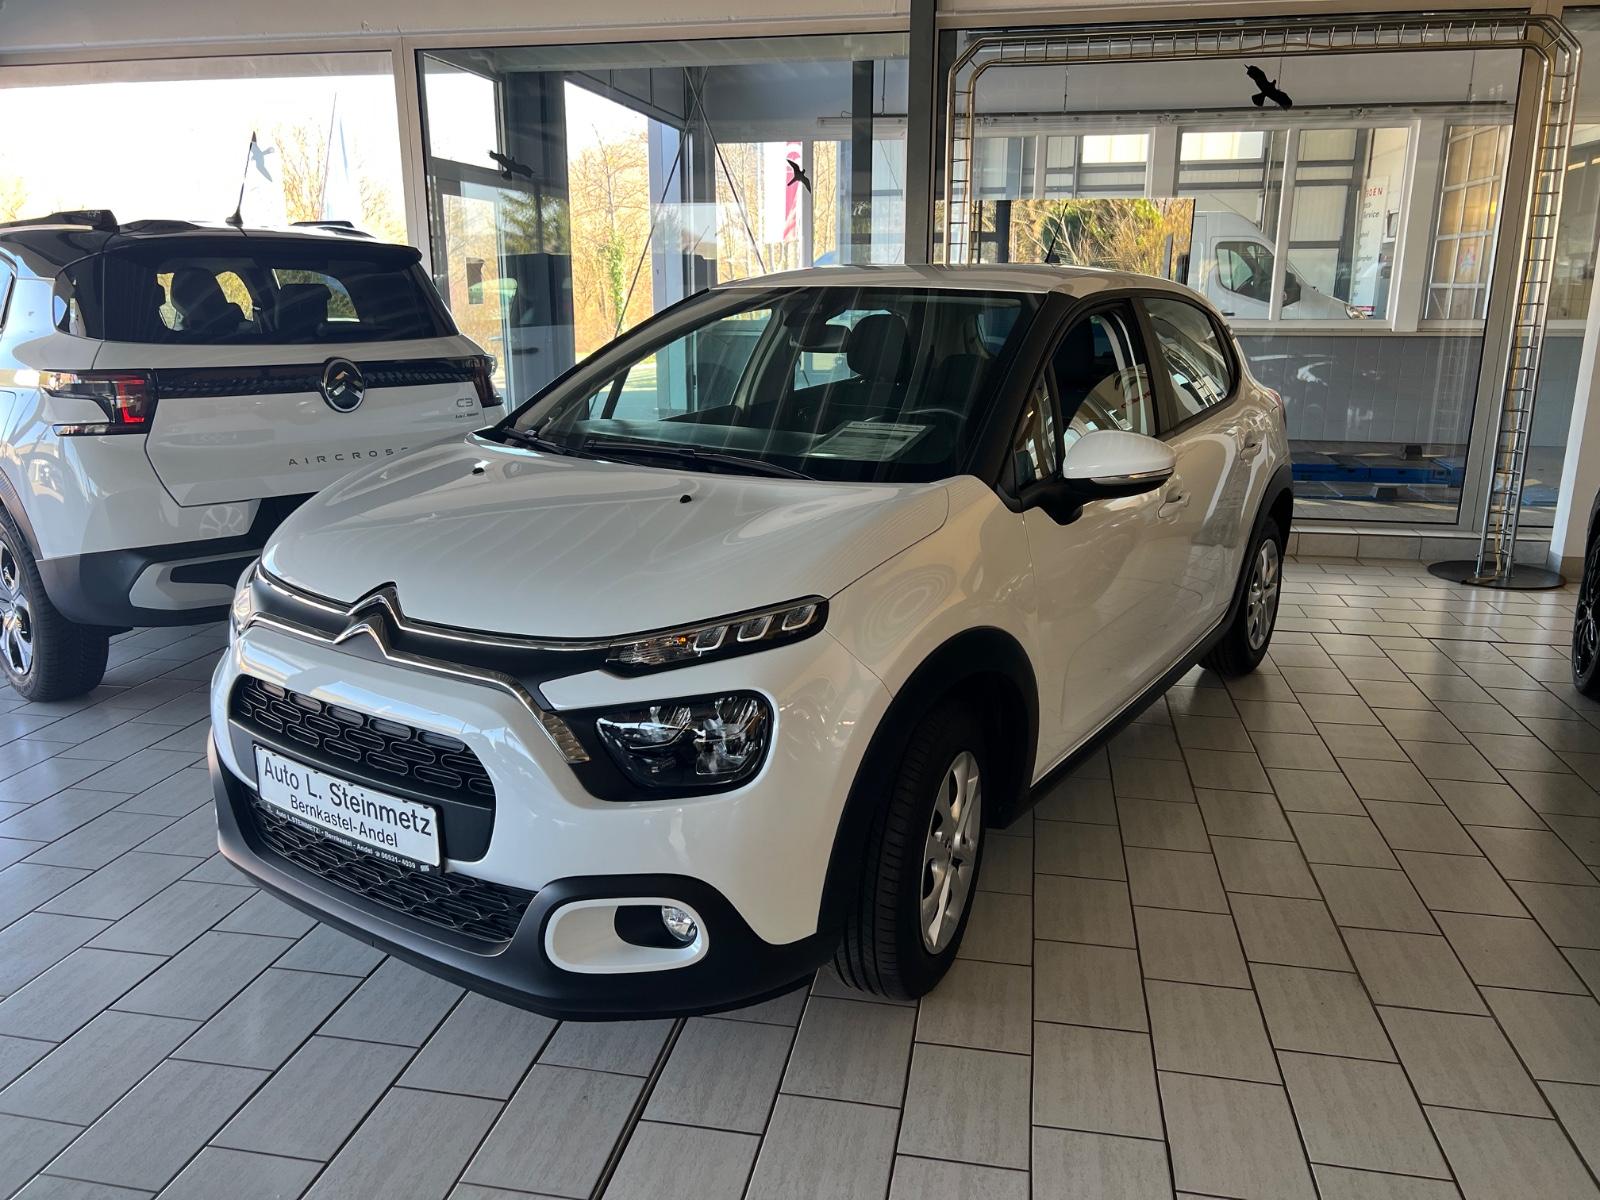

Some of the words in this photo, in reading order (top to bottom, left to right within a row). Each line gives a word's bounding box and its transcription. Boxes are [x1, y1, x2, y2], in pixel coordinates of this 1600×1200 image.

[456, 397, 474, 408] C3
[288, 447, 409, 466] AIRCROS
[264, 757, 299, 790] Auto
[306, 773, 322, 800] L.
[329, 782, 432, 837] Steinmetz
[290, 794, 399, 848] Bernkastel-Andel
